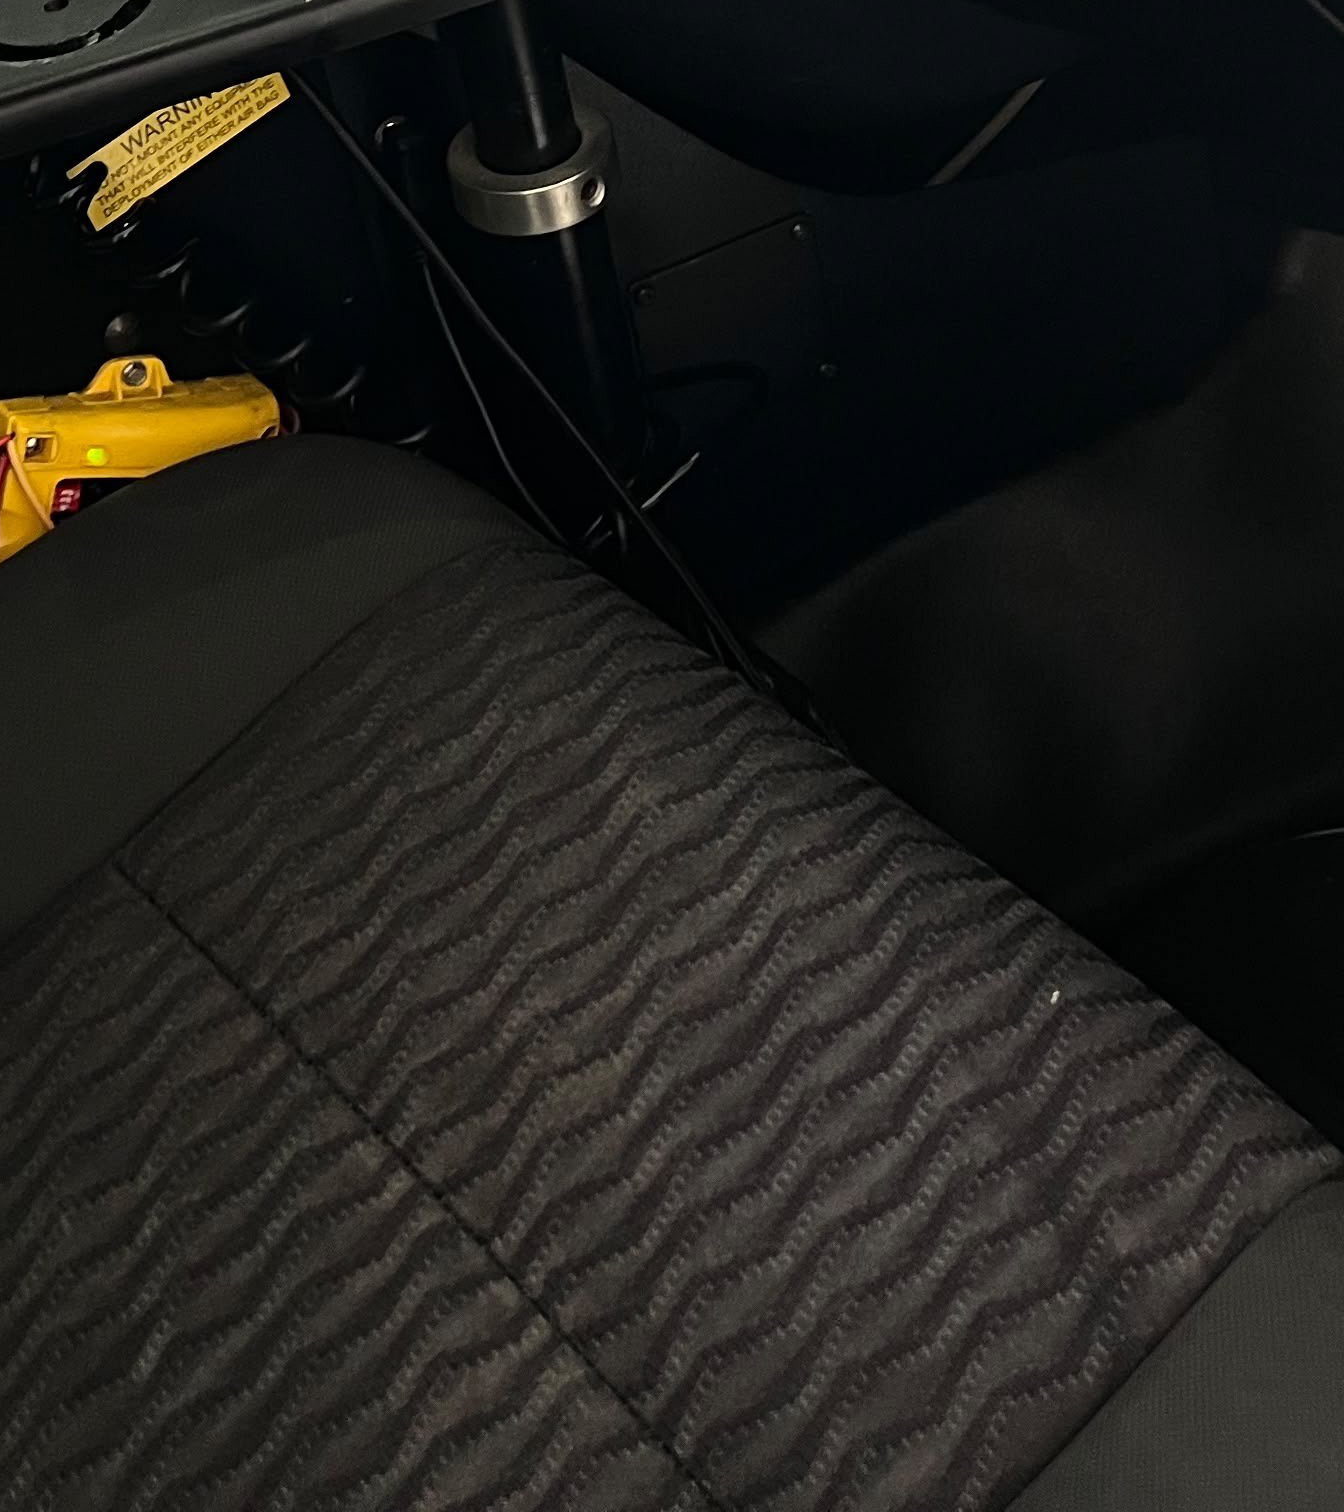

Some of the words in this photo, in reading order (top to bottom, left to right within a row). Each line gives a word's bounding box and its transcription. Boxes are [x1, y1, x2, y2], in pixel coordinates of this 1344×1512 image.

[97, 181, 126, 205] THAT
[129, 162, 156, 183] WILL
[157, 116, 221, 164] INTERFERE
[220, 94, 251, 118] WITH
[251, 77, 274, 98] THE
[102, 160, 176, 218] DEPLOYMENT
[179, 148, 193, 163] OF
[197, 120, 237, 152] EITHER
[238, 106, 255, 124] AIR
[256, 89, 280, 109] BAG
[110, 158, 135, 180] NOT
[137, 130, 176, 163] MOUNT
[183, 112, 201, 132] ANY
[120, 93, 212, 154] WARNIN
